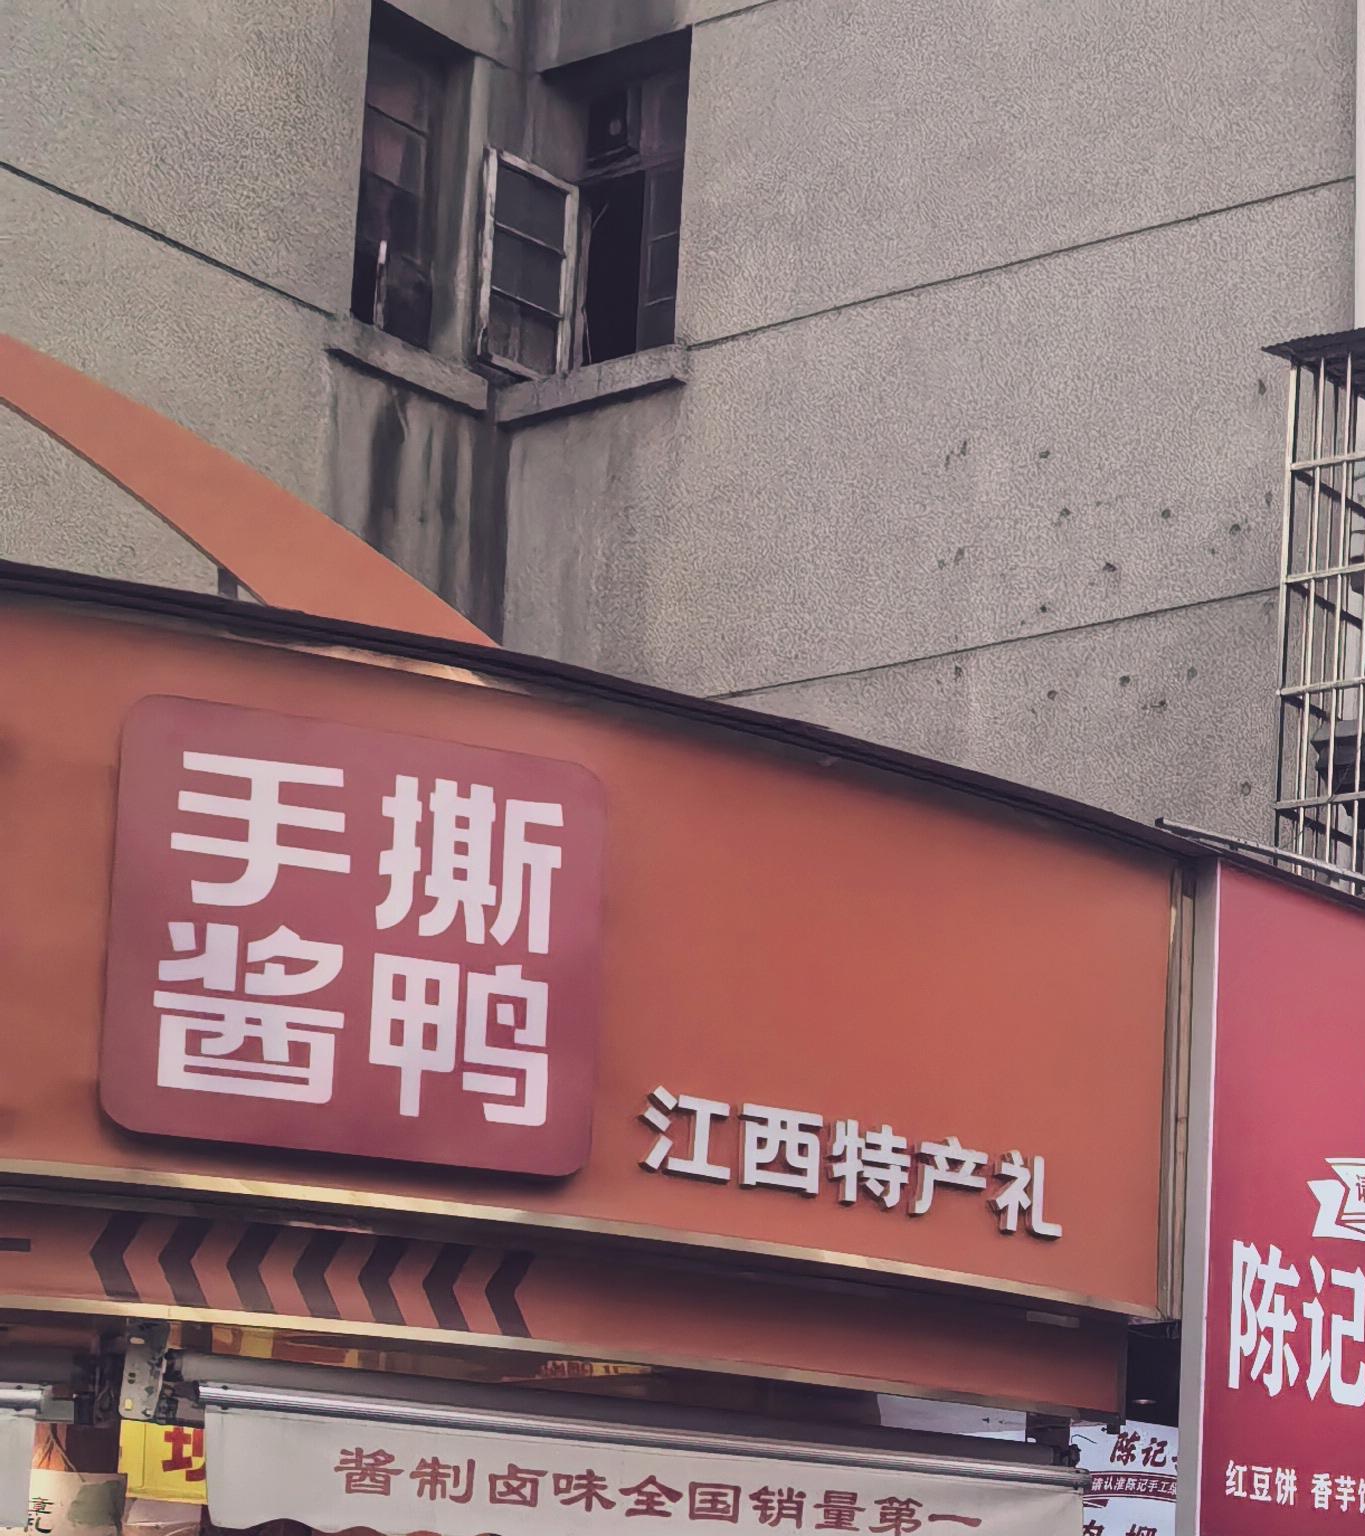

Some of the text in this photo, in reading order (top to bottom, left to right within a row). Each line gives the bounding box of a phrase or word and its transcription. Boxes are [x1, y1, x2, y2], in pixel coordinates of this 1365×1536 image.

[171, 751, 564, 955] 手撕
[154, 921, 548, 1126] 酱鸭
[638, 1084, 1064, 1240] 江西特产礼
[1110, 1431, 1177, 1470] 陈记
[1226, 1459, 1297, 1506] 红豆饼
